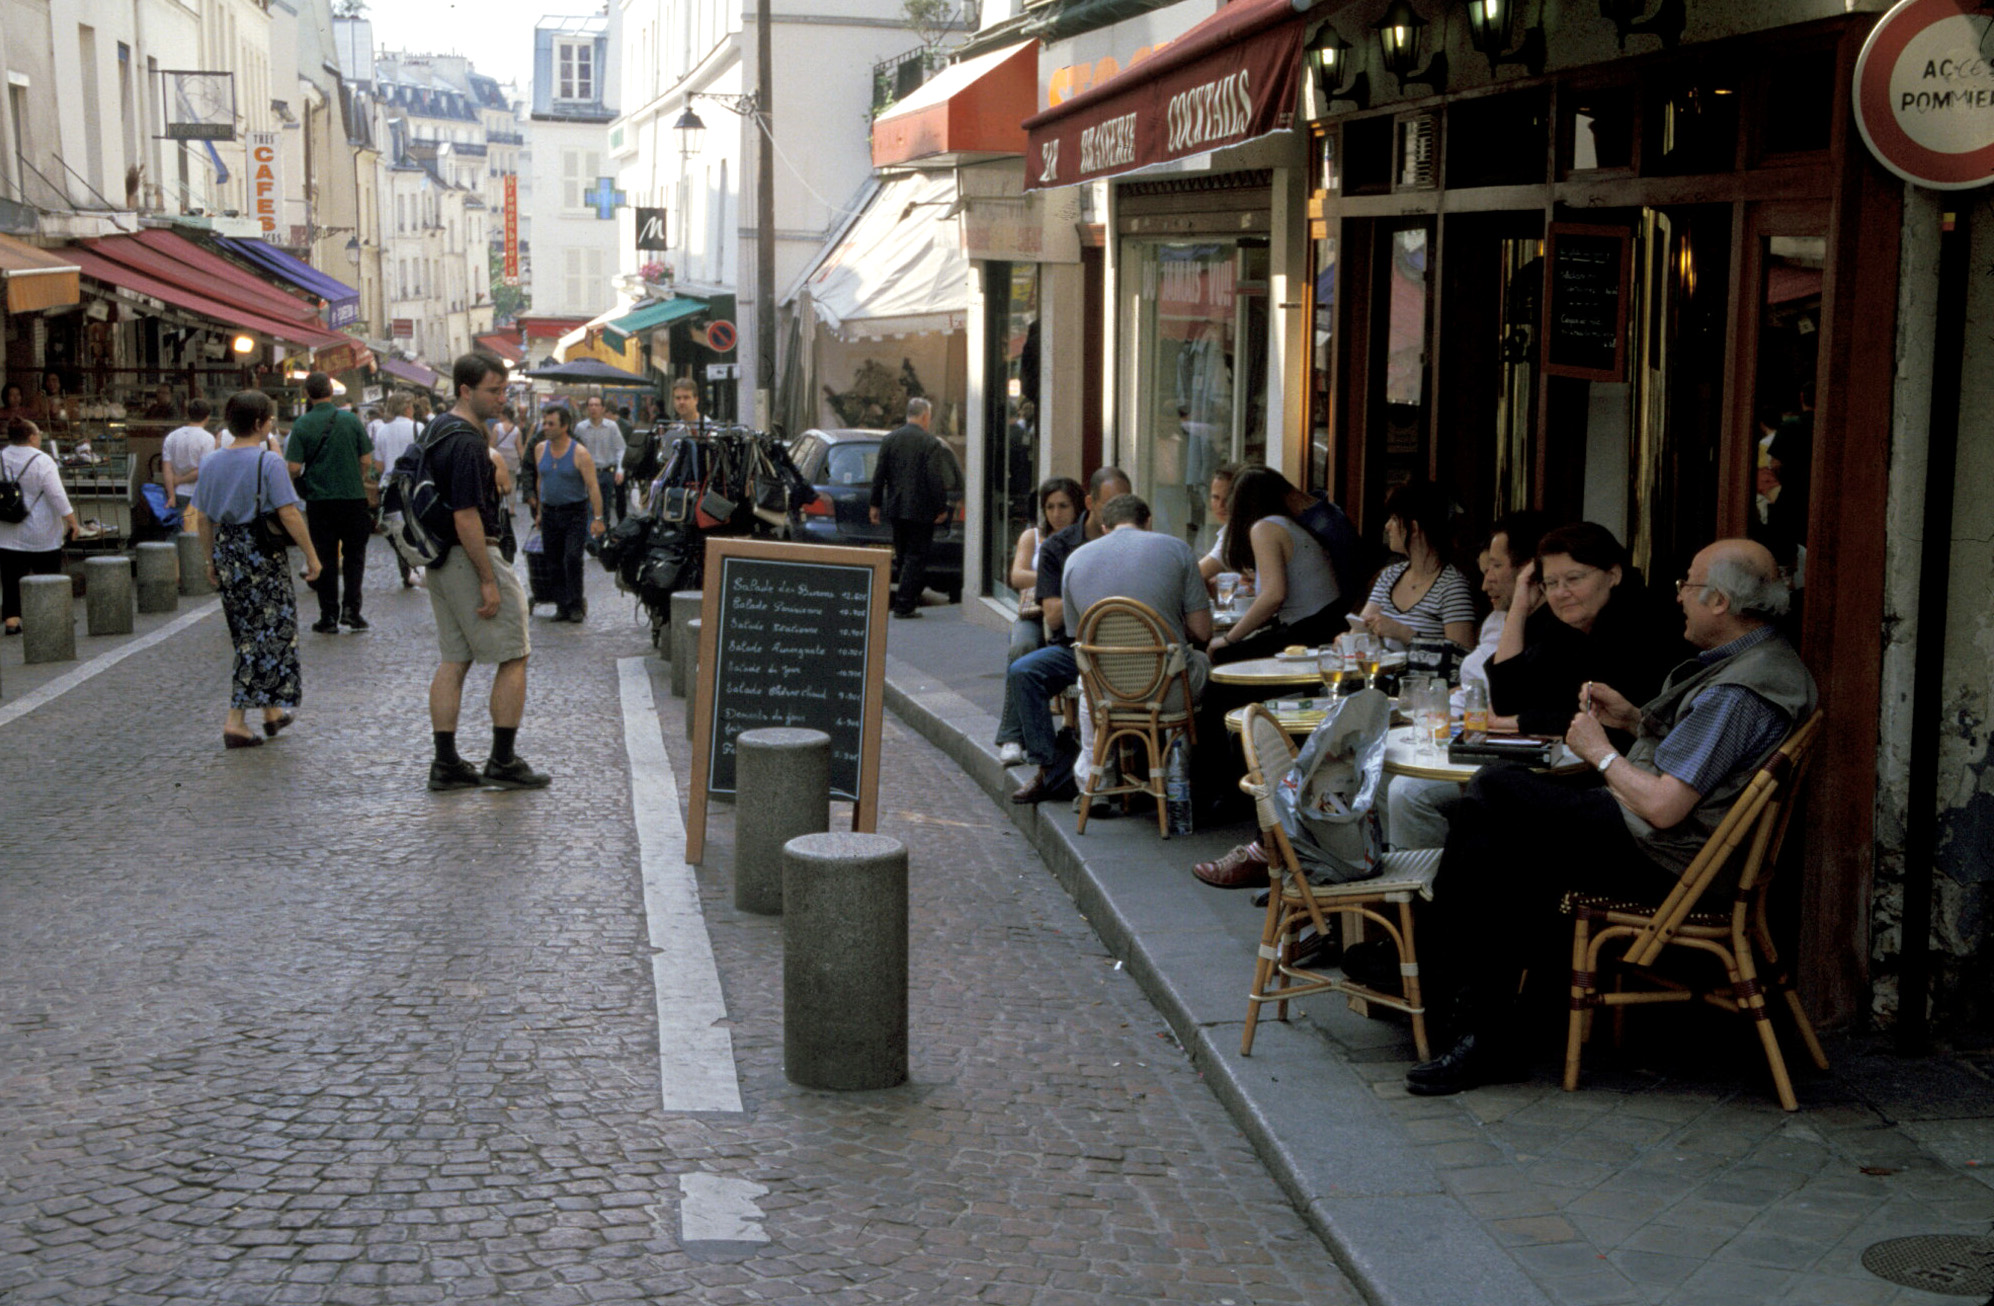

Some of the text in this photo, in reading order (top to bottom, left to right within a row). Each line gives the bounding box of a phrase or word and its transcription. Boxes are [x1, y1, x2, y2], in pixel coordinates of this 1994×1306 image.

[1168, 68, 1252, 152] COCKTAILS
[253, 146, 276, 232] CAFES
[733, 577, 774, 593] Salade
[732, 597, 768, 611] Salade
[728, 639, 763, 654] Salade
